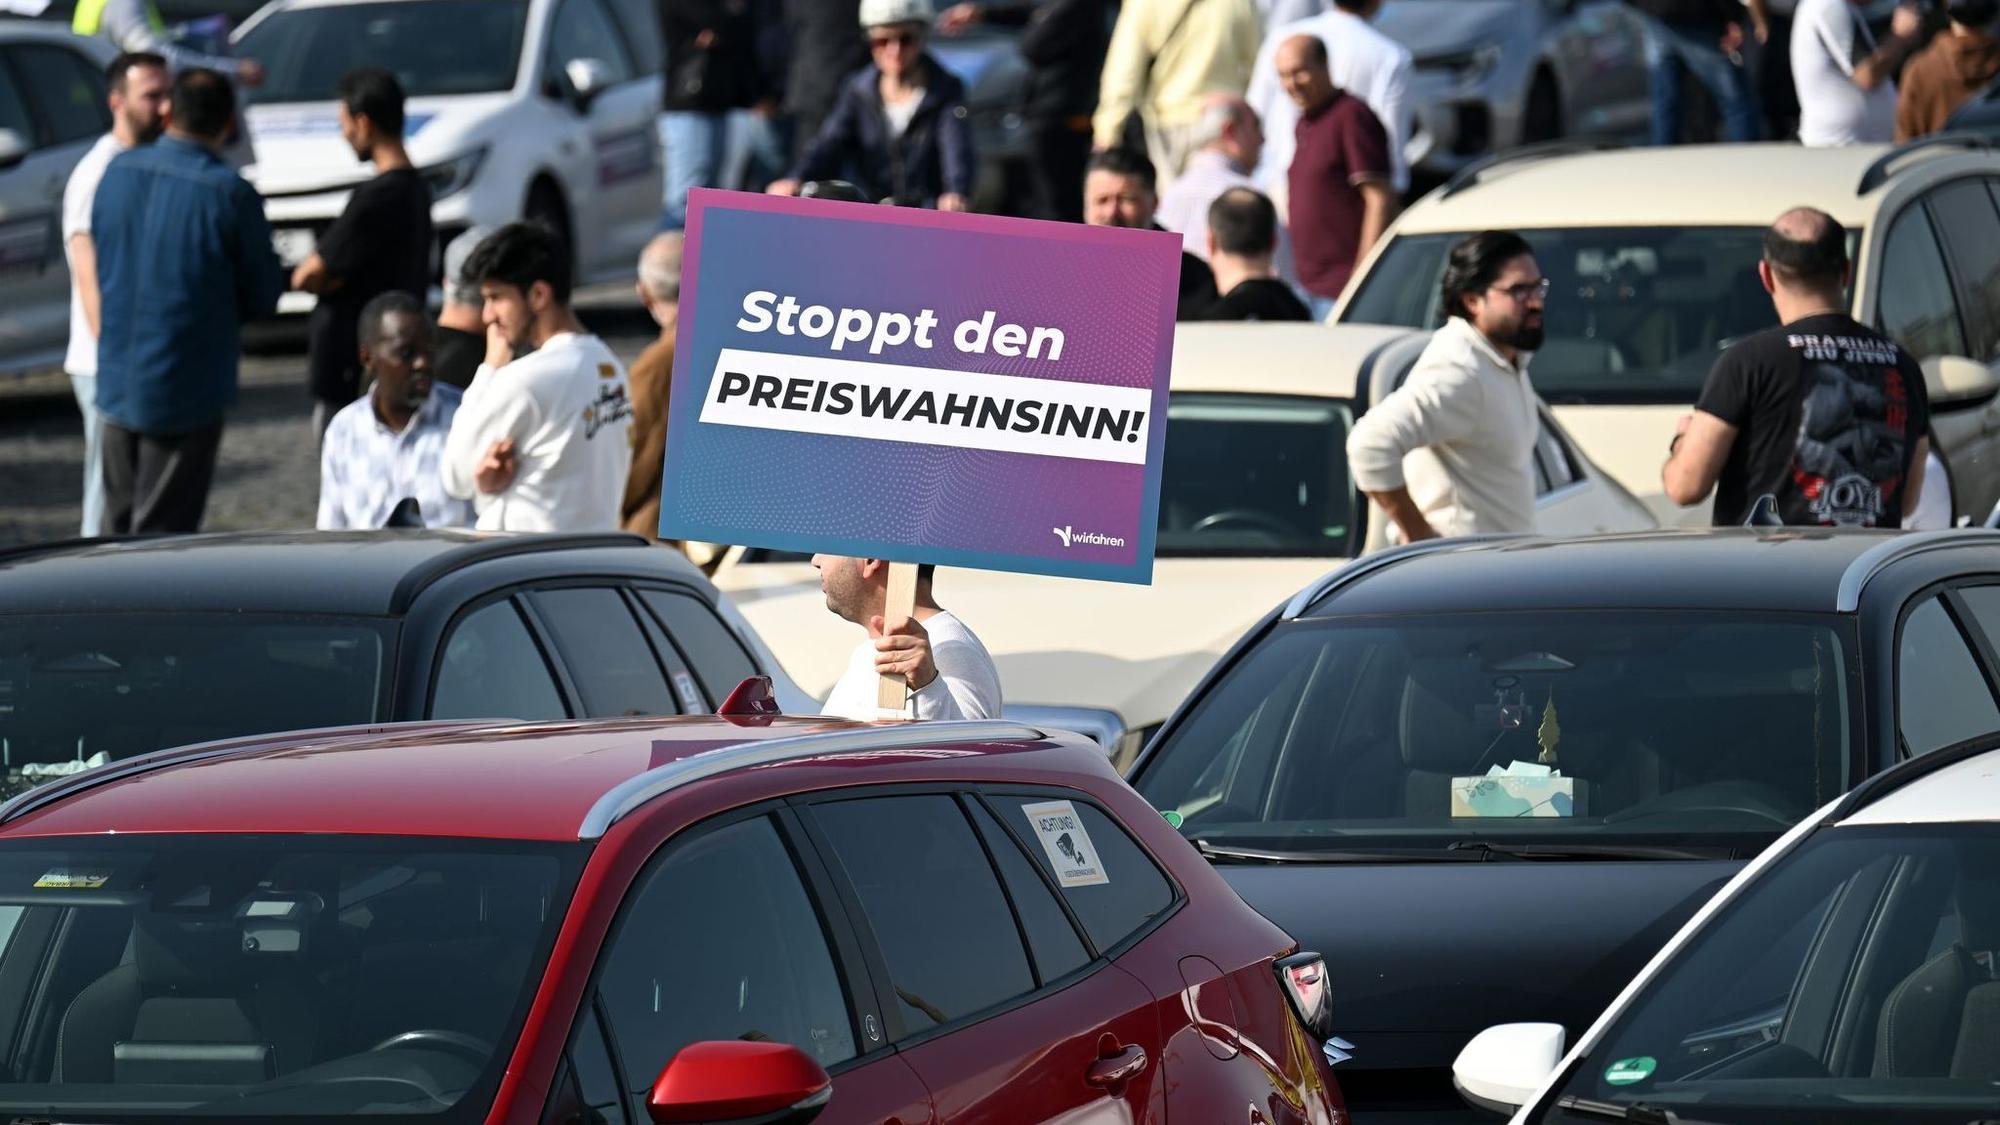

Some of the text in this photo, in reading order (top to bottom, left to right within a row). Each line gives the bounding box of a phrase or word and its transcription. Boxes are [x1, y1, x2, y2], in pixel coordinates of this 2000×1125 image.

[737, 291, 1065, 360] Stoppt den
[716, 372, 1145, 443] PREISWAHNSINN!
[1072, 531, 1125, 547] wirfahren
[1038, 815, 1077, 833] ACHTUNG!
